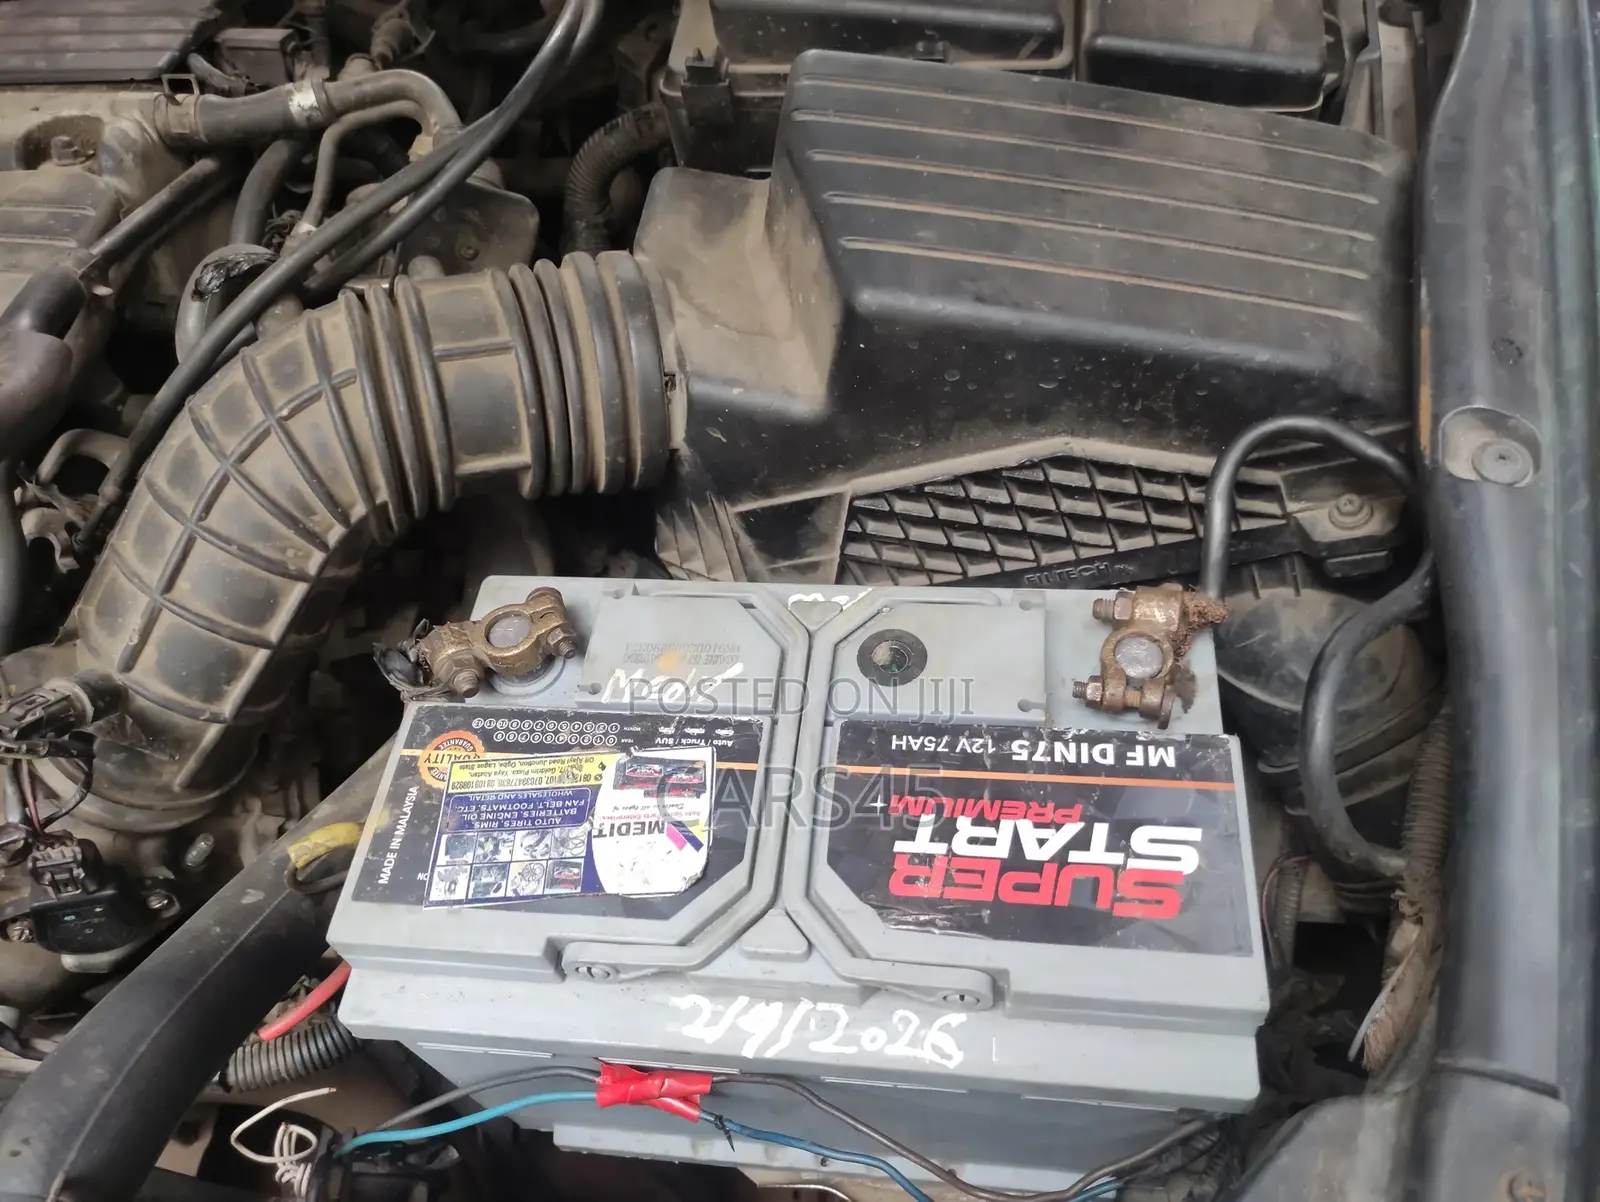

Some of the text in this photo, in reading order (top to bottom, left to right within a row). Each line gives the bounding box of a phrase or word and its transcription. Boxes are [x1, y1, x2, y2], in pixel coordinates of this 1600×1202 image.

[438, 738, 474, 752] GUARANTEE
[655, 737, 674, 745] SUV
[681, 738, 706, 746] Truck
[712, 739, 734, 747] Auto
[891, 734, 1177, 768] MF DIN75 12V 75AH
[476, 761, 496, 770] Lagos
[548, 758, 566, 766] Road
[459, 763, 475, 771] State
[564, 799, 585, 807] FAN
[887, 794, 1083, 824] PREMIUM
[480, 811, 518, 819] ENGINE
[535, 817, 562, 825] AUTO
[593, 820, 665, 839] MEDIT
[377, 785, 420, 884] MADE IN MALAYSIA
[892, 813, 1203, 875] START
[888, 853, 1184, 920] SUPER
